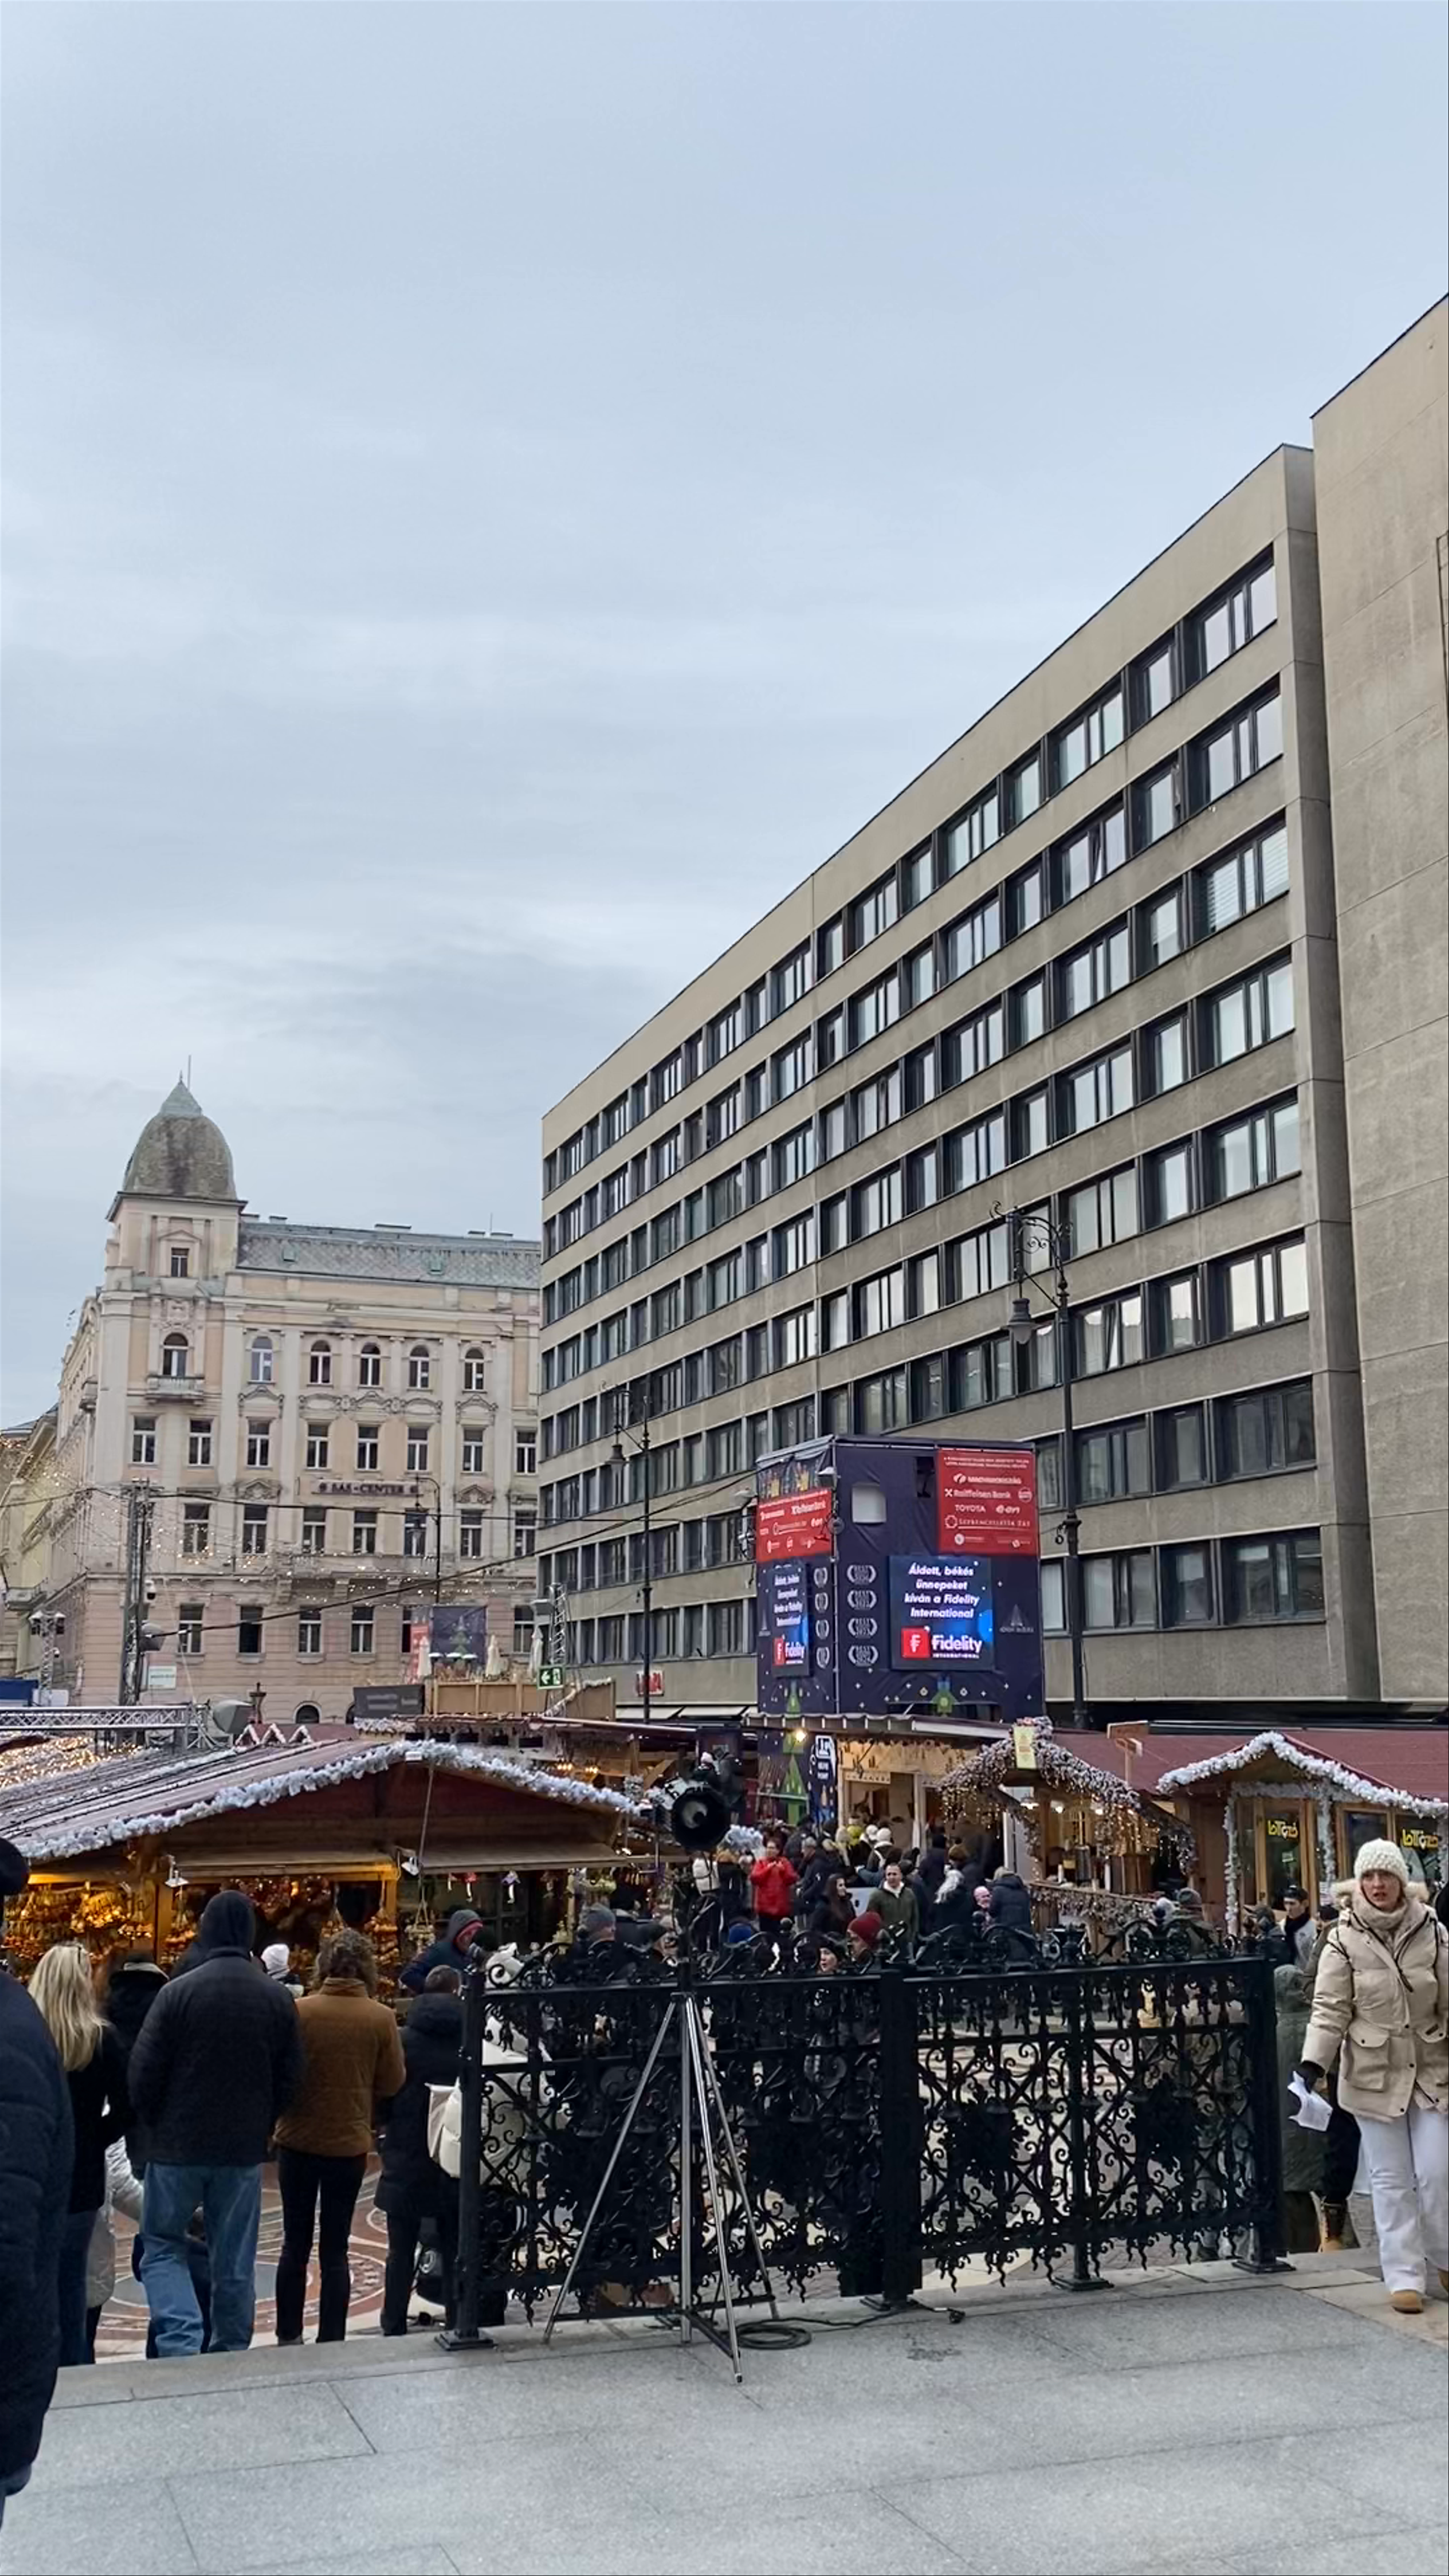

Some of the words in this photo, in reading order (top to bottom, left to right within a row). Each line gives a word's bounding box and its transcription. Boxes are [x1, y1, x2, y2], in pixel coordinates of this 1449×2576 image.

[954, 1489, 991, 1498] Raiffeisen
[955, 1504, 986, 1513] TOYOTA
[908, 1562, 941, 1576] Áldott,
[944, 1566, 974, 1576] békés
[916, 1579, 968, 1592] ünnepeket
[904, 1593, 931, 1603] kíván
[944, 1594, 980, 1606] Fidelity
[910, 1607, 974, 1618] International
[932, 1635, 982, 1653] Fidelity
